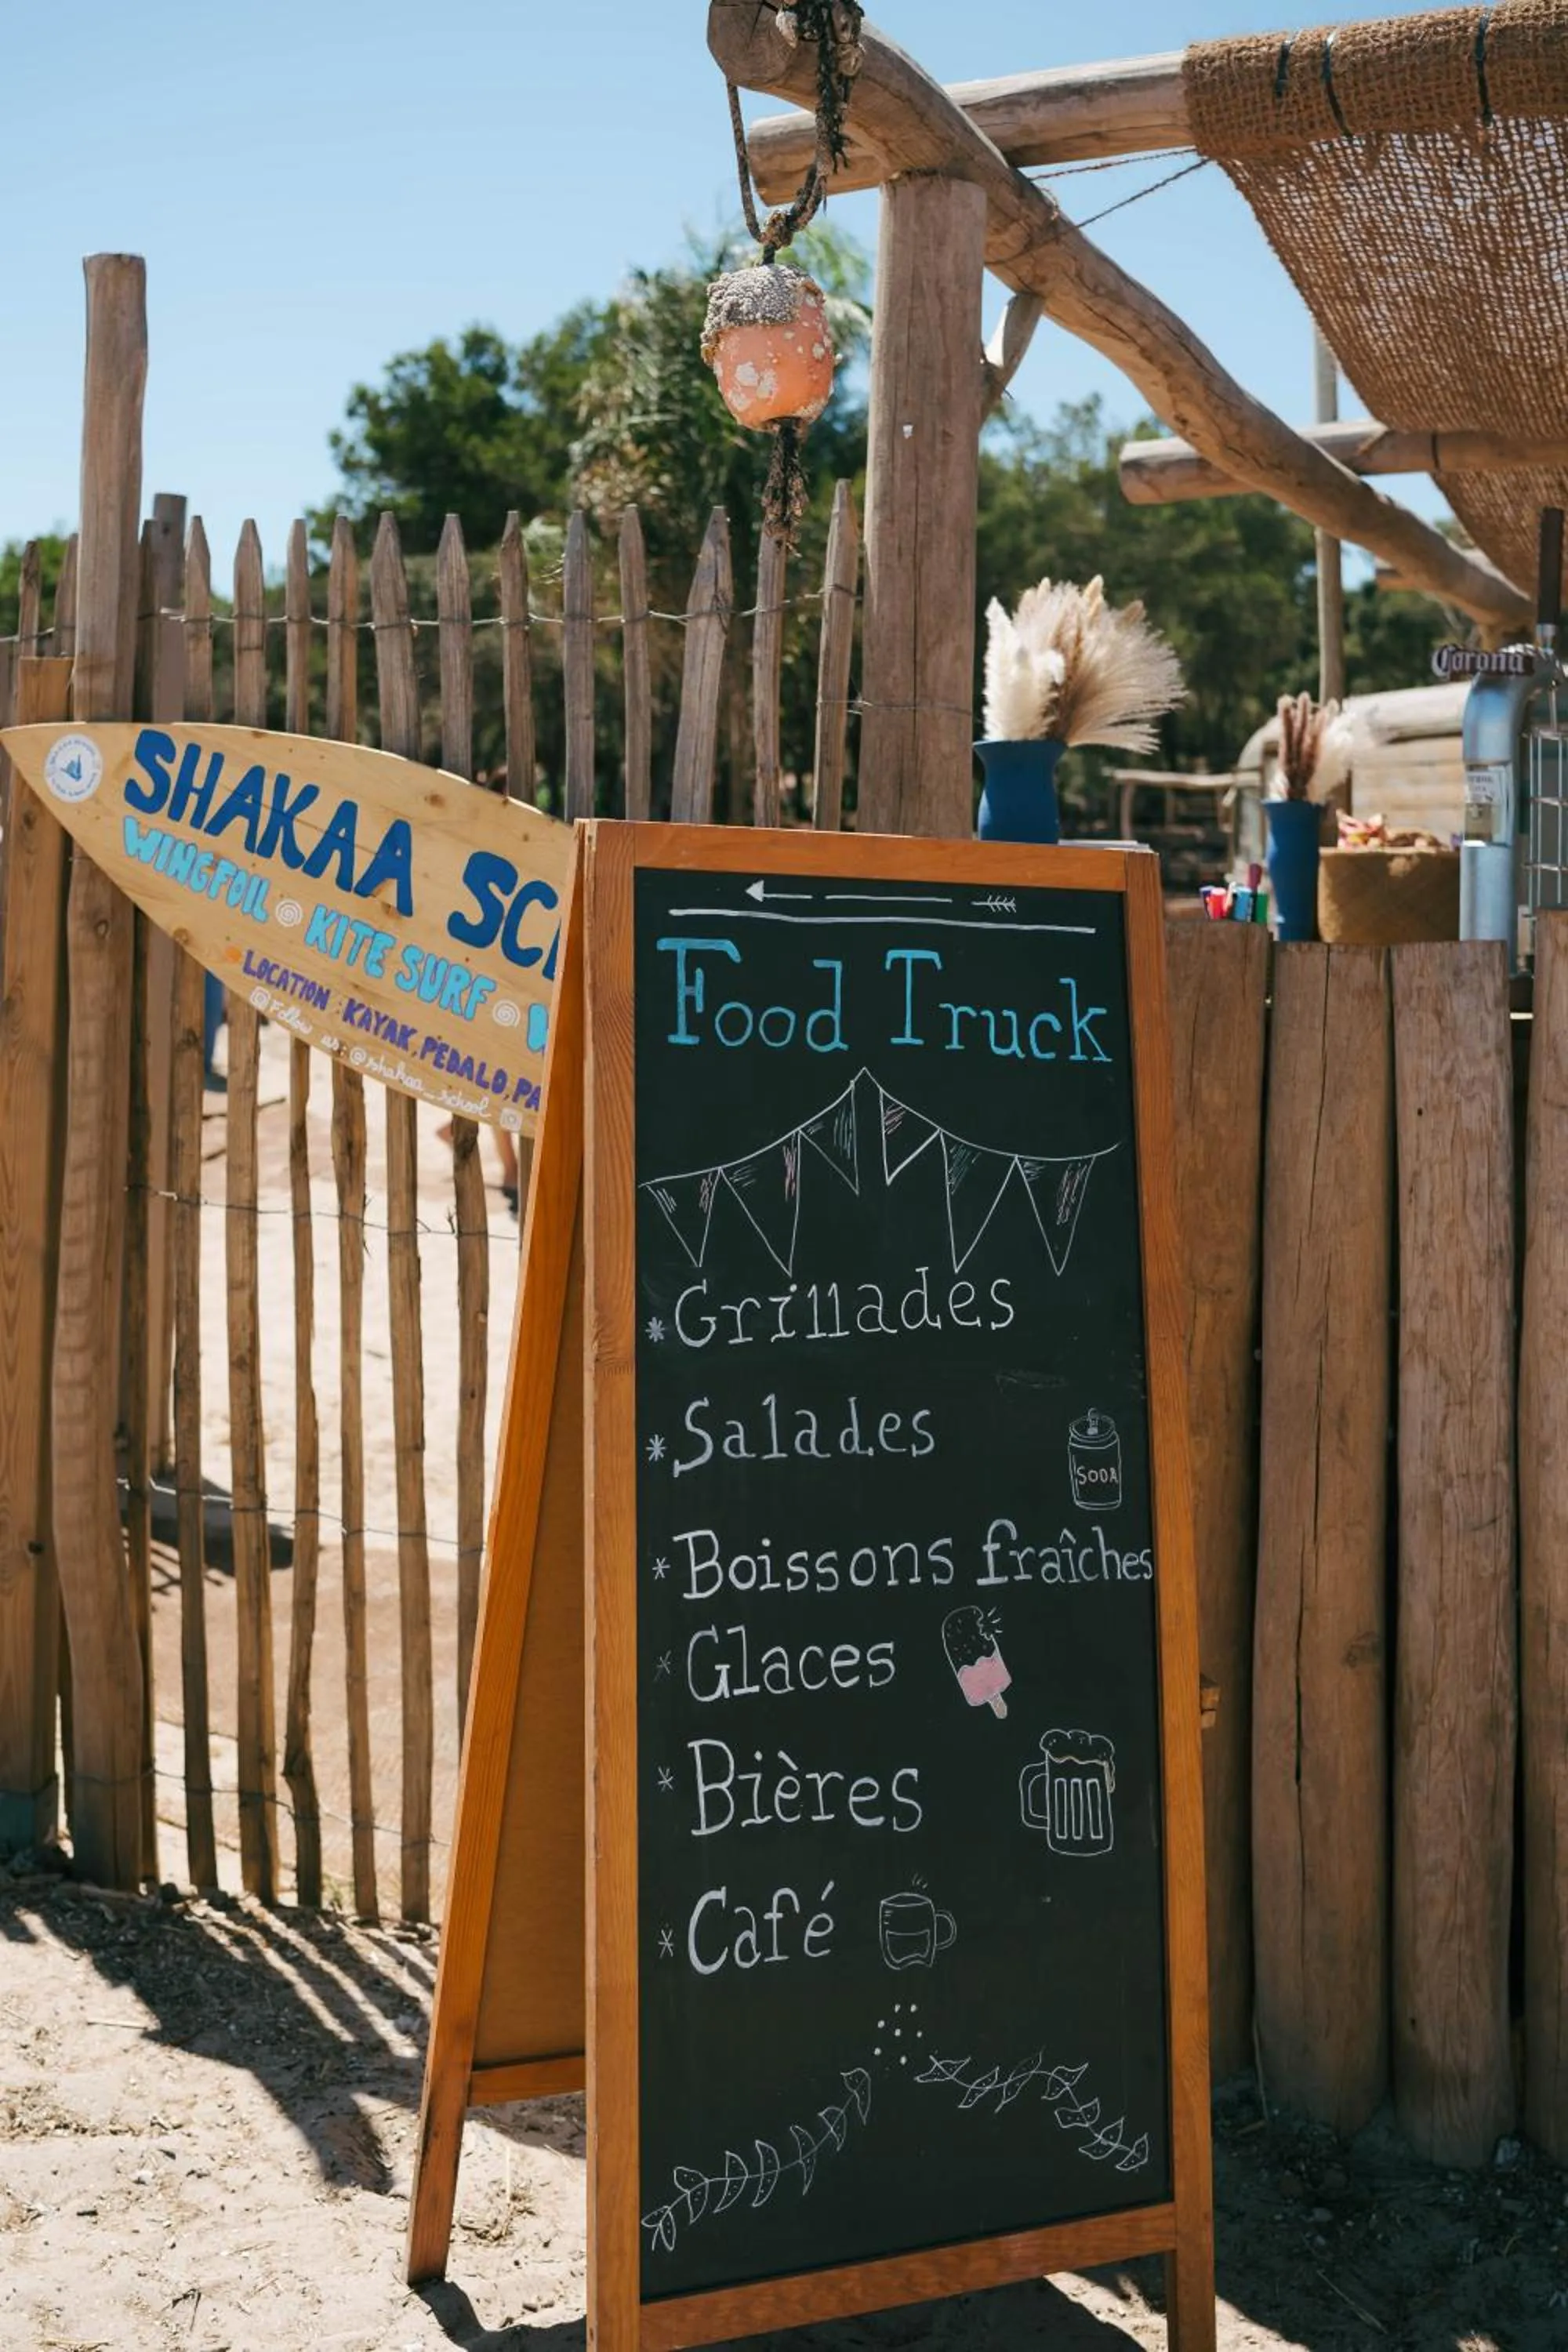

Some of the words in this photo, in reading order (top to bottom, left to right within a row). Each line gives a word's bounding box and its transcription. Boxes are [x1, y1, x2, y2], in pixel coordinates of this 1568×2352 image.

[1432, 645, 1524, 678] Corona
[123, 729, 413, 917] SHAKAA
[447, 851, 562, 982] SC
[123, 815, 270, 923] WINGFOIL
[304, 903, 397, 979] KITE
[394, 945, 496, 1022] SURF
[243, 949, 331, 1011] LOCATION
[656, 938, 849, 1053] Food
[886, 949, 1112, 1062] Truck
[675, 1267, 1015, 1348] Grillades
[673, 1393, 935, 1478] Salades
[1076, 1465, 1120, 1485] SODA
[673, 1529, 955, 1601] Boissons
[976, 1519, 1154, 1587] fraîches
[687, 1625, 896, 1702] Glaces
[687, 1738, 923, 1836] Bières
[688, 1880, 835, 1975] Café
